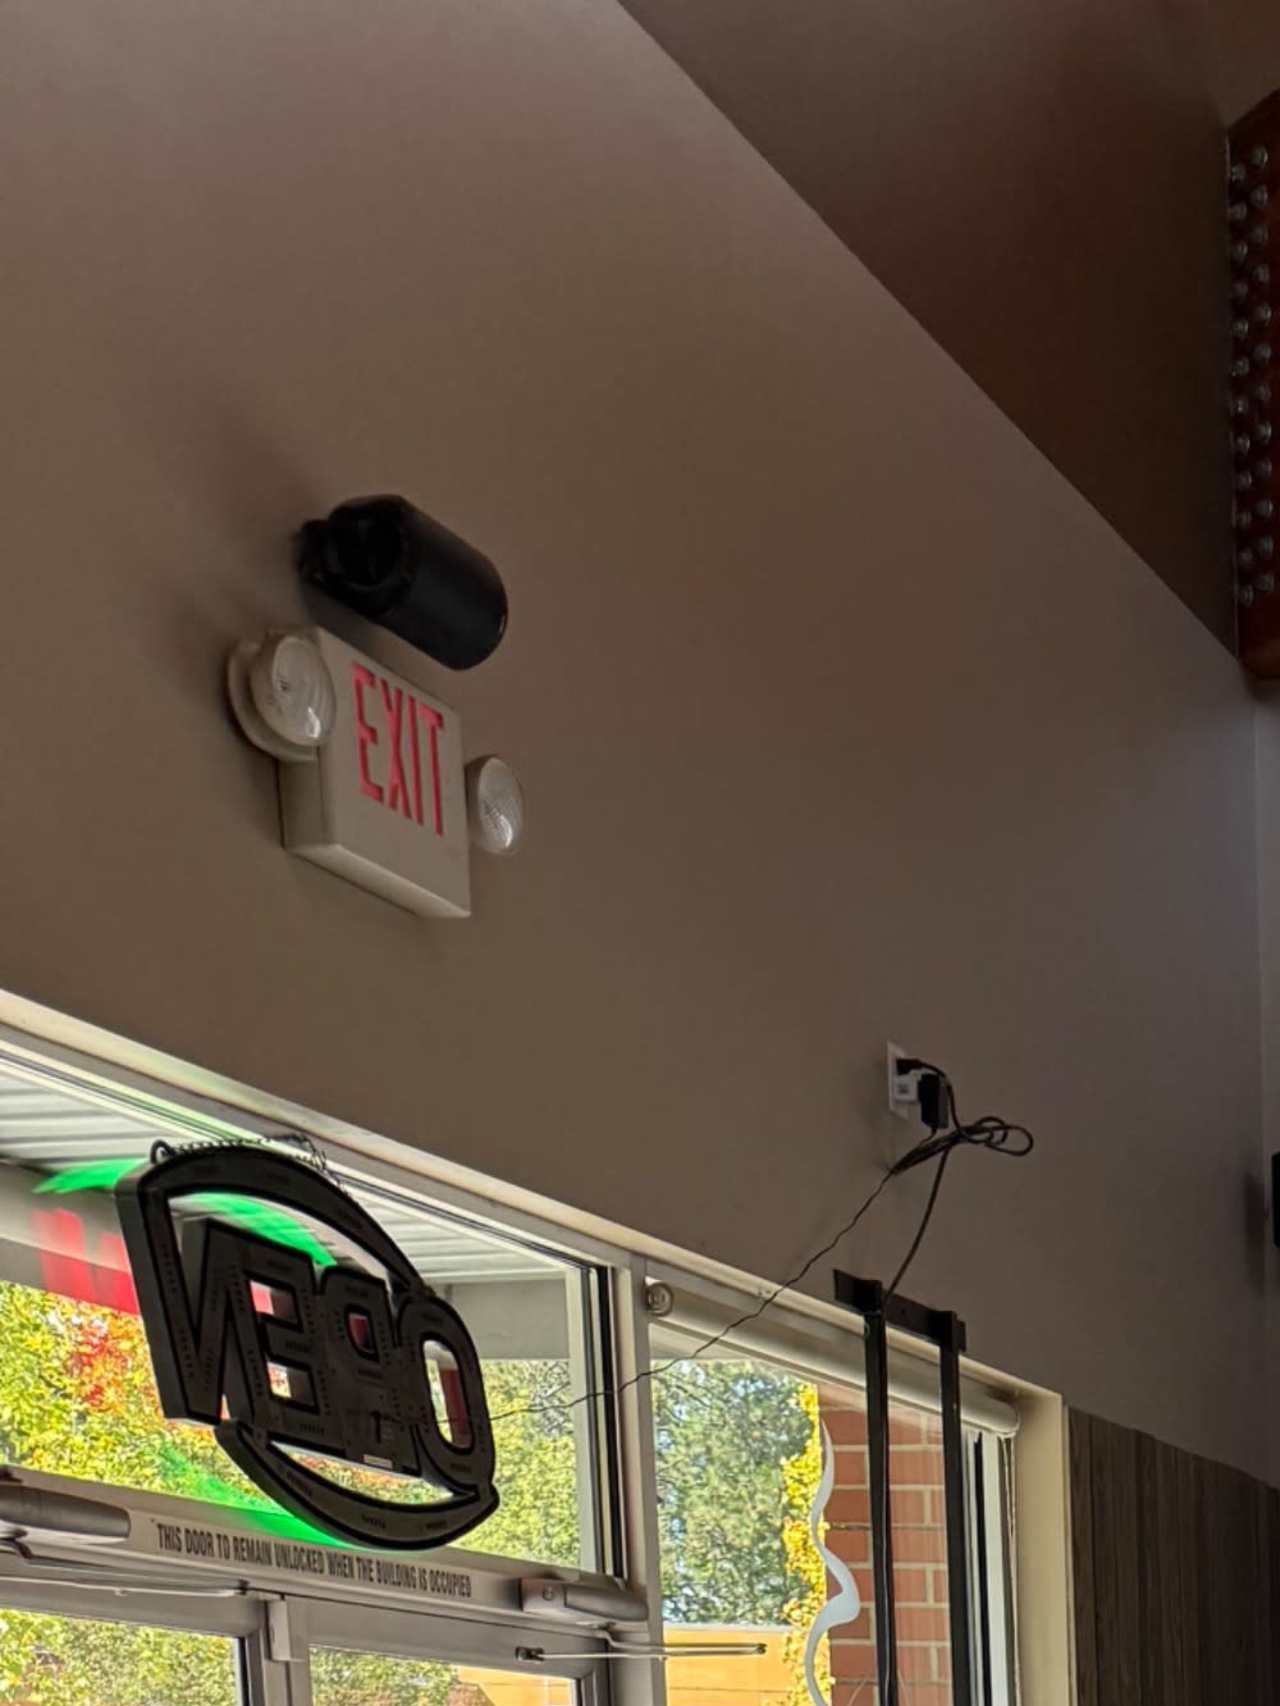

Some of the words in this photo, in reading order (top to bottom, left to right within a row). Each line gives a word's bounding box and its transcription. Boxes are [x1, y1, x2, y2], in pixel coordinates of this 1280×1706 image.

[353, 662, 444, 836] EXIT
[157, 1523, 182, 1552] THIS
[184, 1528, 214, 1557] DOOR
[216, 1533, 230, 1560] TO
[232, 1536, 272, 1567] REMAIN
[274, 1543, 324, 1574] UNLOCKED
[327, 1552, 354, 1578] WHEN
[356, 1556, 374, 1582] THE
[376, 1560, 417, 1589] BUILDING
[418, 1567, 428, 1591] IS
[429, 1569, 472, 1598] OCCUPIED
